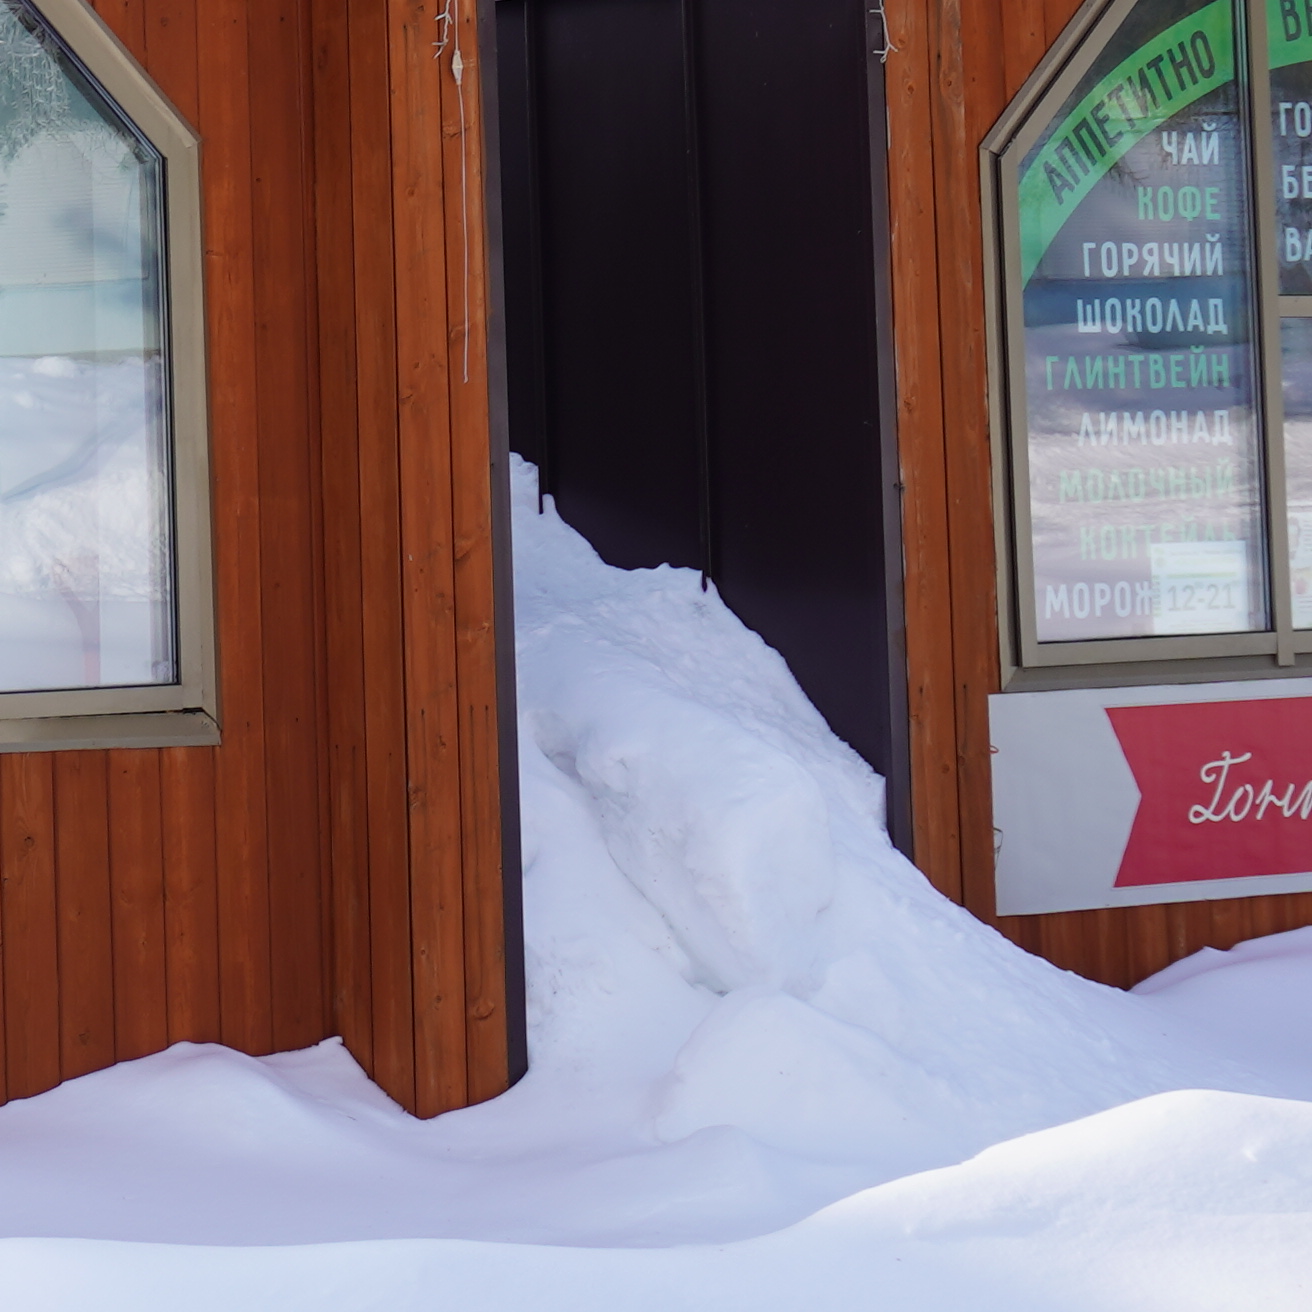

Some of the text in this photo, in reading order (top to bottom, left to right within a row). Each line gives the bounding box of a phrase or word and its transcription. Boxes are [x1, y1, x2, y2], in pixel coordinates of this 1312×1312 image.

[1043, 30, 1216, 206] АППЕТИТНО
[1161, 122, 1220, 166] ЧАЙ
[1138, 186, 1222, 222] КОФЕ
[1082, 233, 1224, 278] ГОРЯЧИЙ
[1077, 297, 1229, 335] ШОКОЛАД
[1045, 345, 1231, 390] ГЛИНТВЕЙН
[1078, 409, 1234, 447] ЛИМОНАД
[1058, 457, 1234, 504] МОЛОЧНЫЙ
[1044, 580, 1154, 620] МОРОЖ
